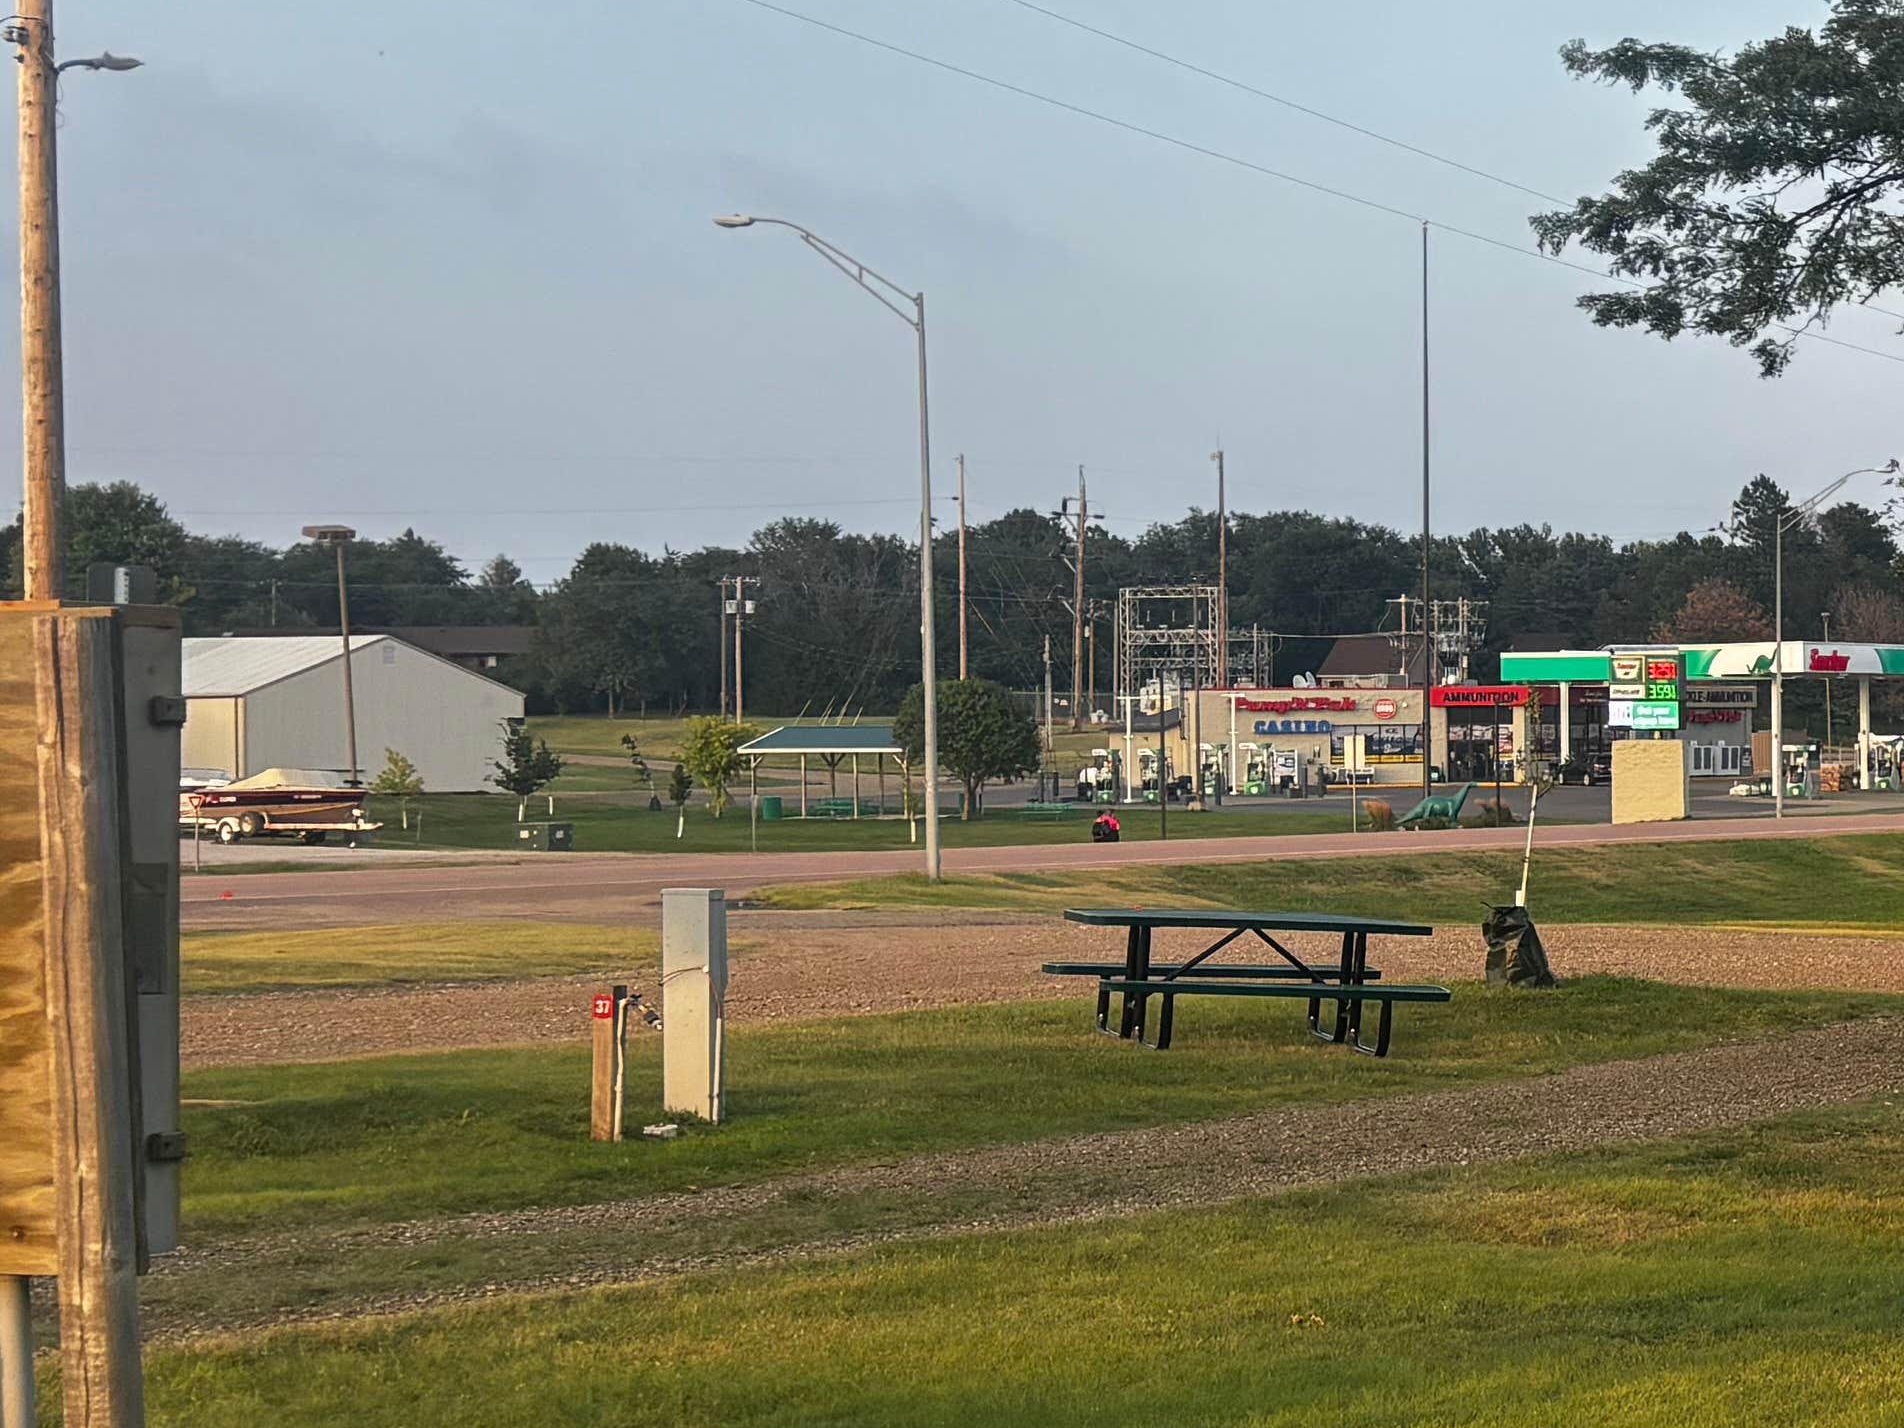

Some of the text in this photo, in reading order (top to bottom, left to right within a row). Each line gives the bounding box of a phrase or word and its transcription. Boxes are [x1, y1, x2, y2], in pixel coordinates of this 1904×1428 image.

[1442, 691, 1519, 703] AMMUNITION
[1254, 720, 1332, 734] CASINO
[595, 999, 611, 1014] 37
